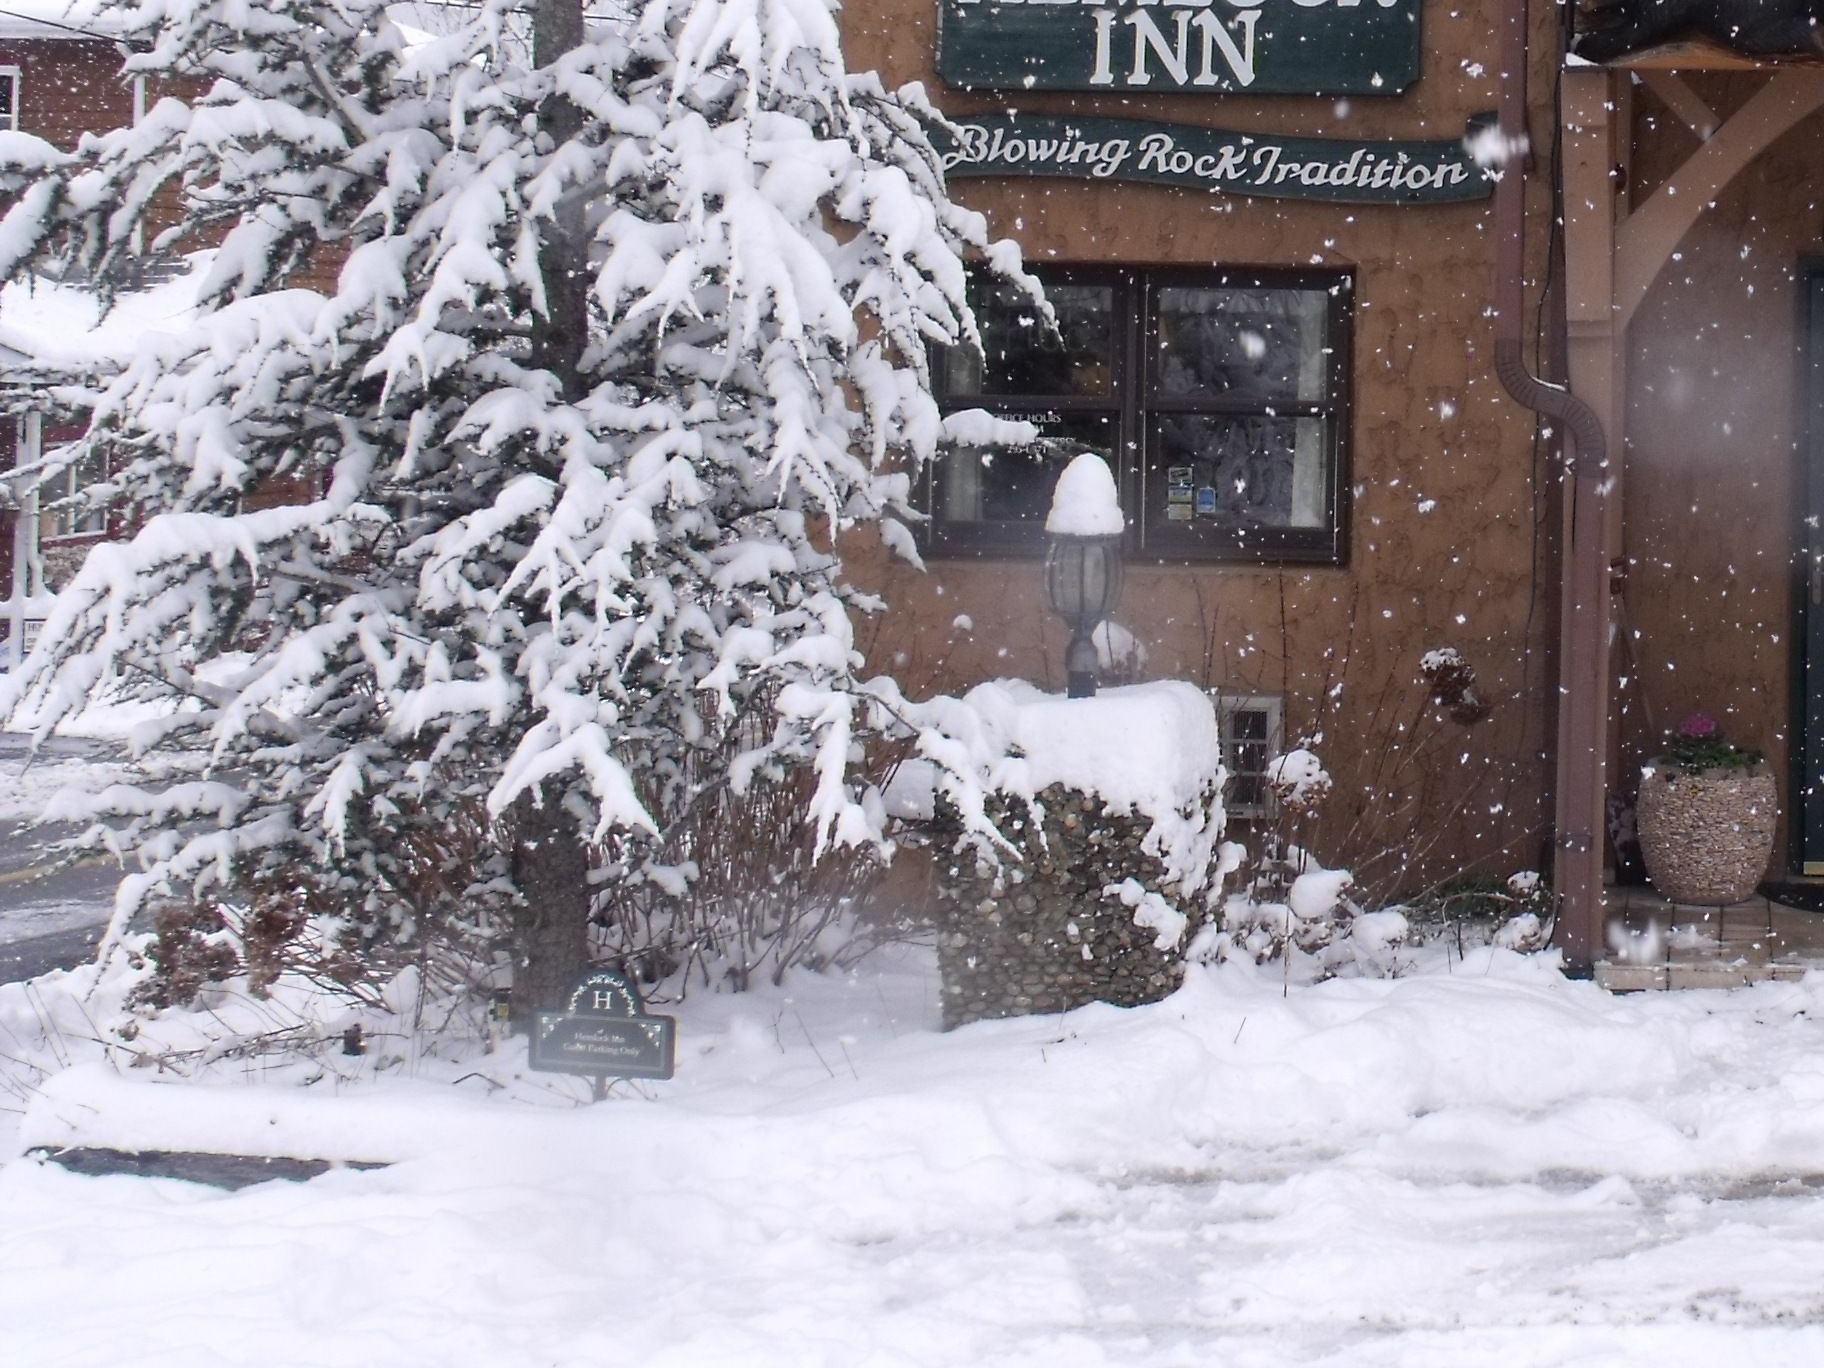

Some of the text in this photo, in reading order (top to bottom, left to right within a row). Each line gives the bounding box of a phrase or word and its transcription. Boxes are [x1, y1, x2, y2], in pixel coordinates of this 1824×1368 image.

[1089, 9, 1262, 87] INN
[942, 124, 1132, 177] Blowing
[1252, 145, 1469, 190] Tradition
[592, 990, 613, 1010] H
